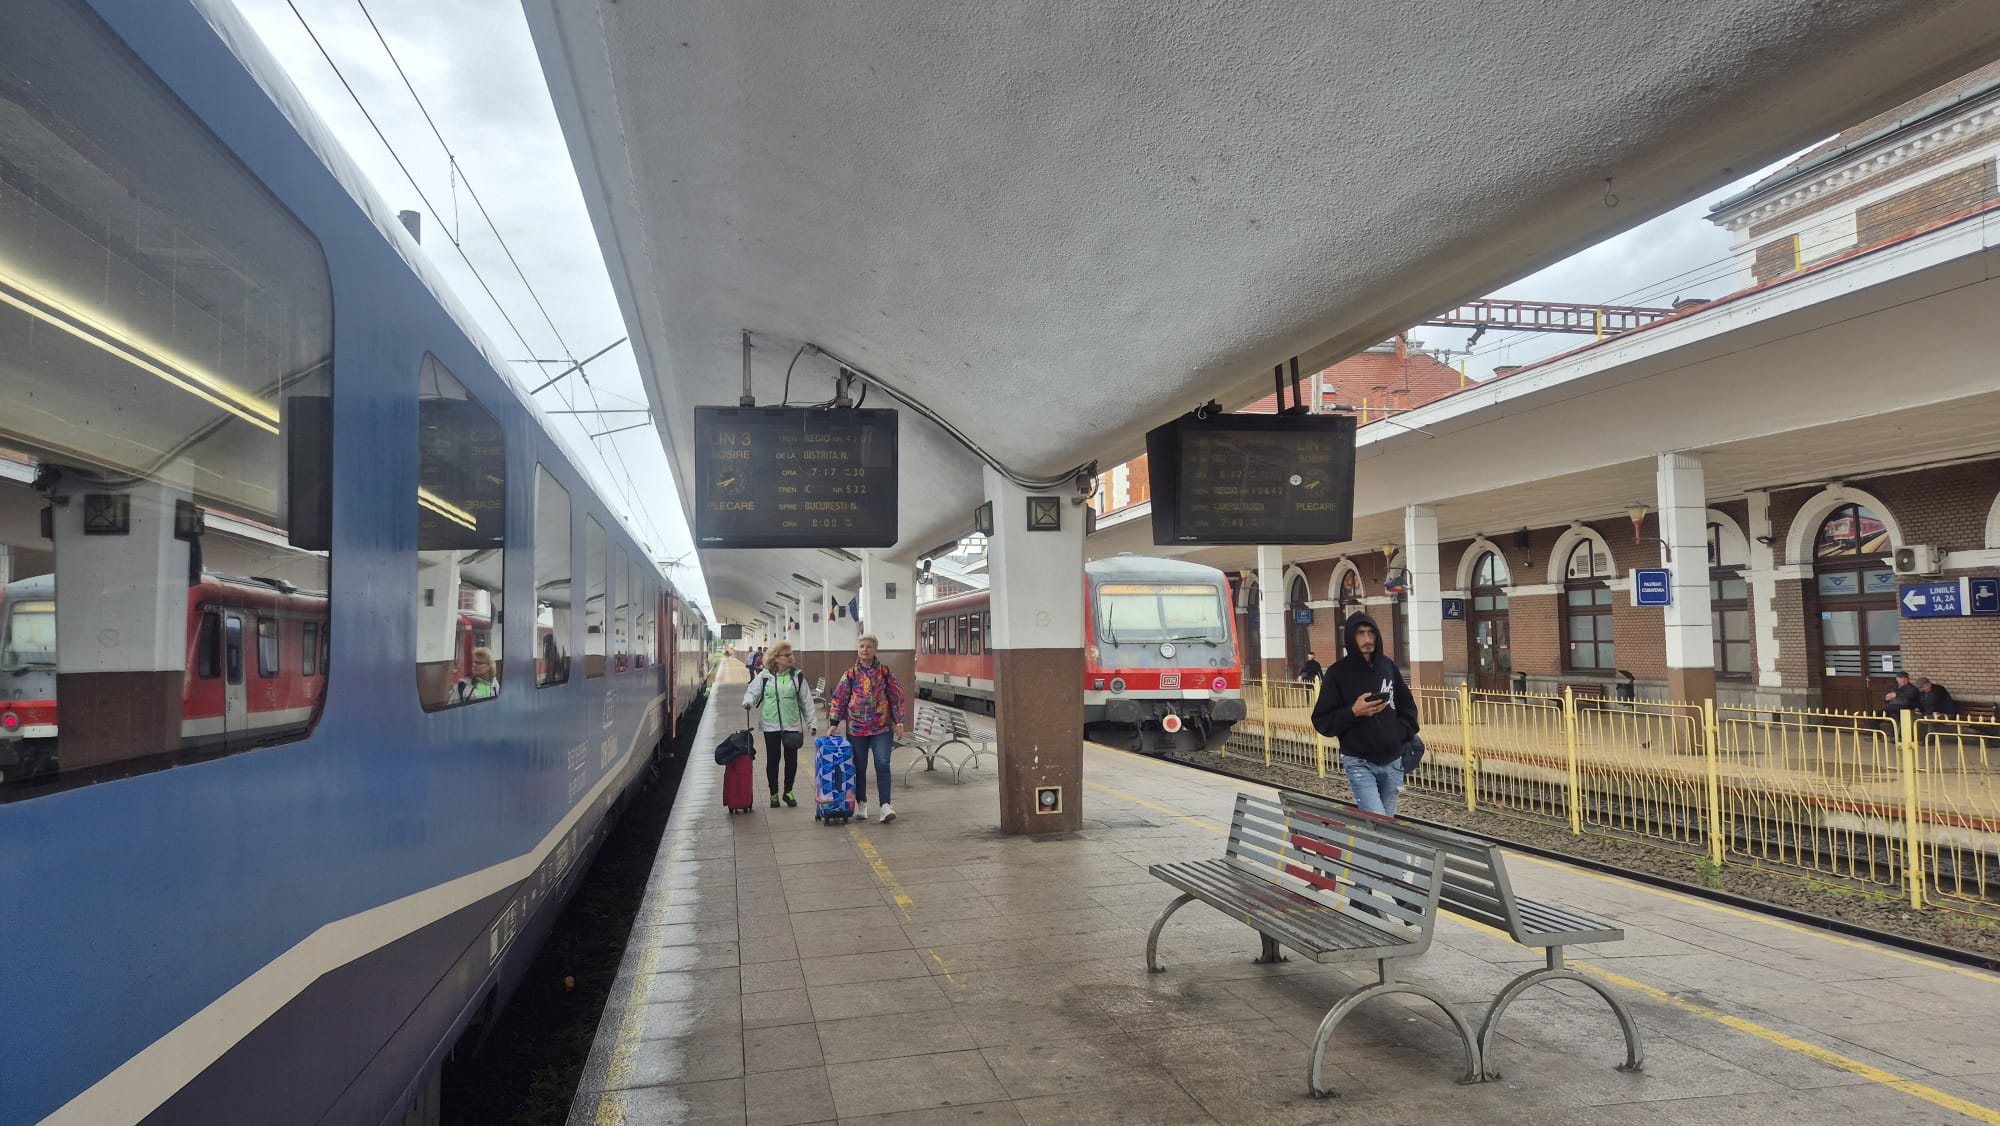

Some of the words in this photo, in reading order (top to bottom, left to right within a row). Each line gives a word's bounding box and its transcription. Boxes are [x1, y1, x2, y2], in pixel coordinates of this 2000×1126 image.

[741, 432, 752, 446] 3
[804, 433, 831, 443] REGIO
[713, 449, 751, 459] OSIRE
[781, 469, 798, 477] ORA
[778, 486, 797, 494] TREN
[804, 484, 812, 494] IC
[845, 484, 867, 494] 532
[1295, 502, 1337, 512] PLECARE
[782, 520, 798, 528] ORA
[1930, 586, 1956, 594] LINIILE
